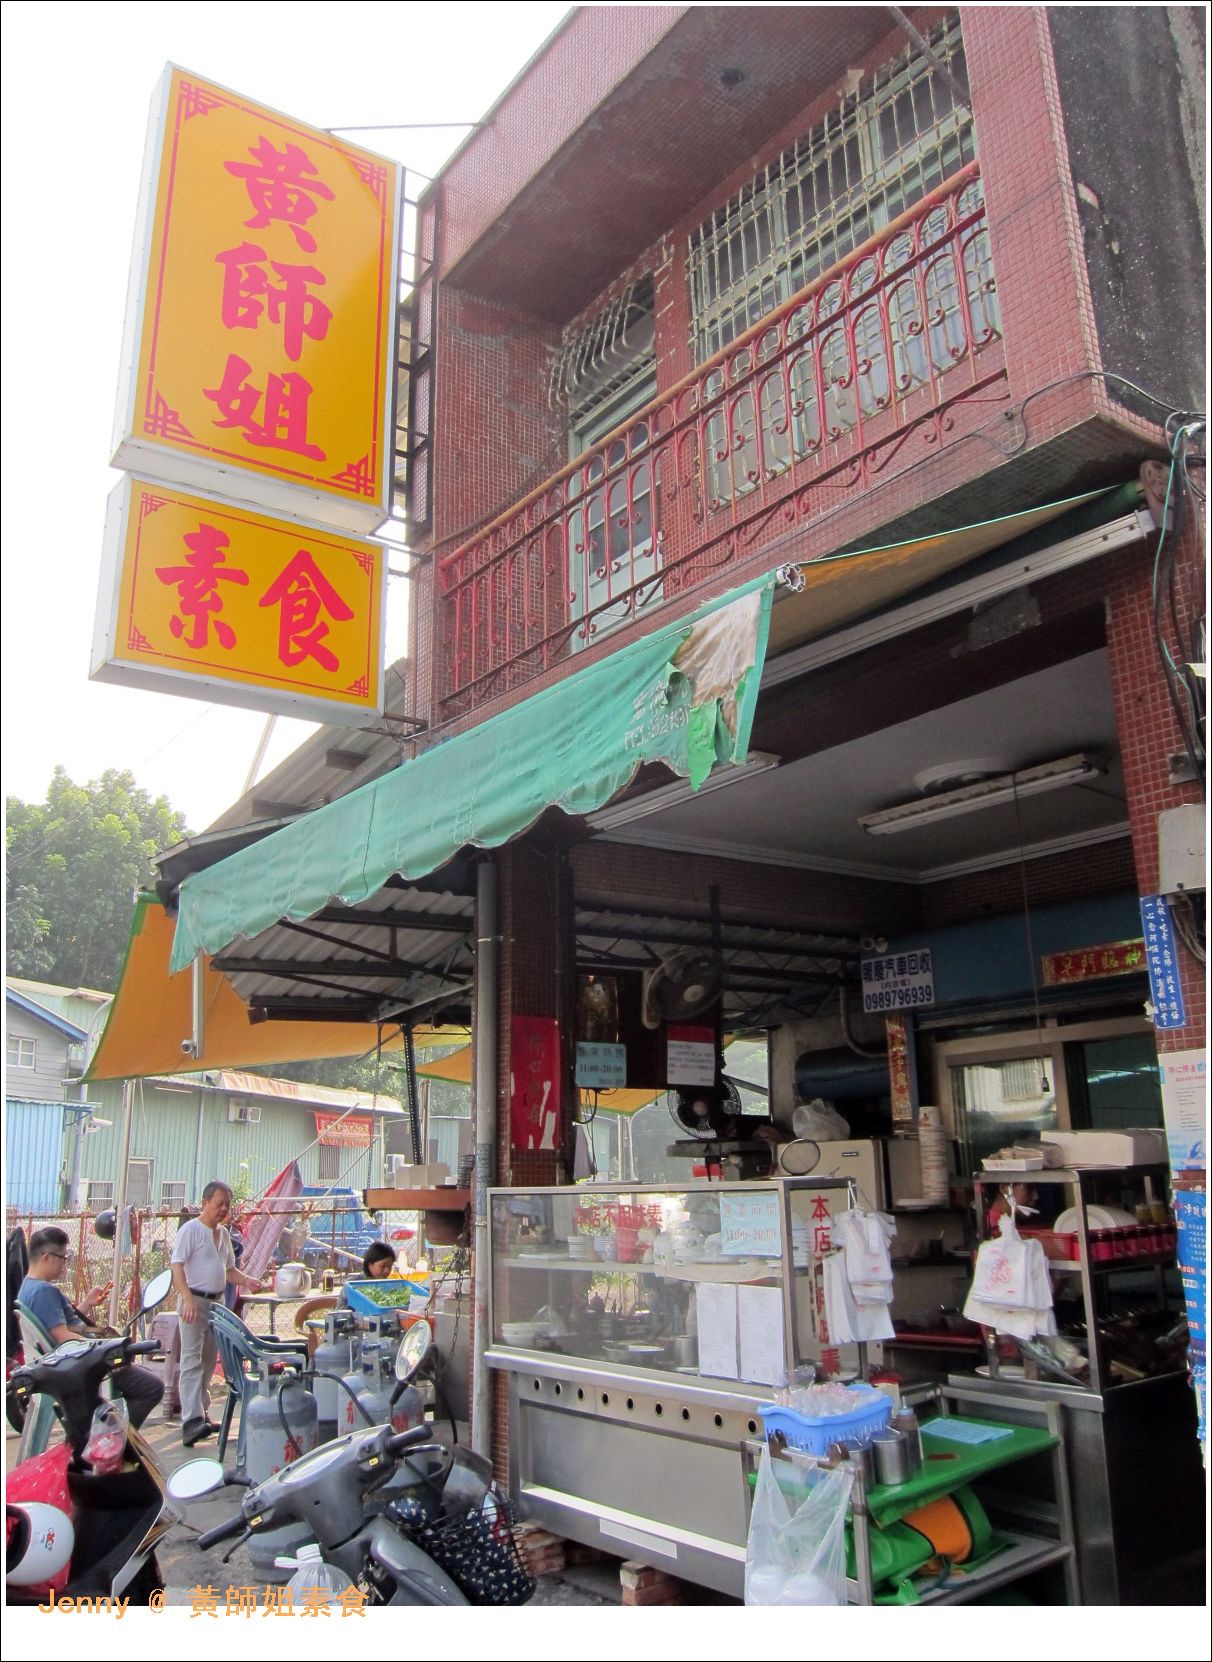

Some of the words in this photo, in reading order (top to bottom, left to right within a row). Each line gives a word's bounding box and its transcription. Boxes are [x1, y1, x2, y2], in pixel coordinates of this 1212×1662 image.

[203, 136, 337, 463] 黃師姐
[155, 523, 355, 673] 素食
[865, 985, 932, 1011] 0989796939
